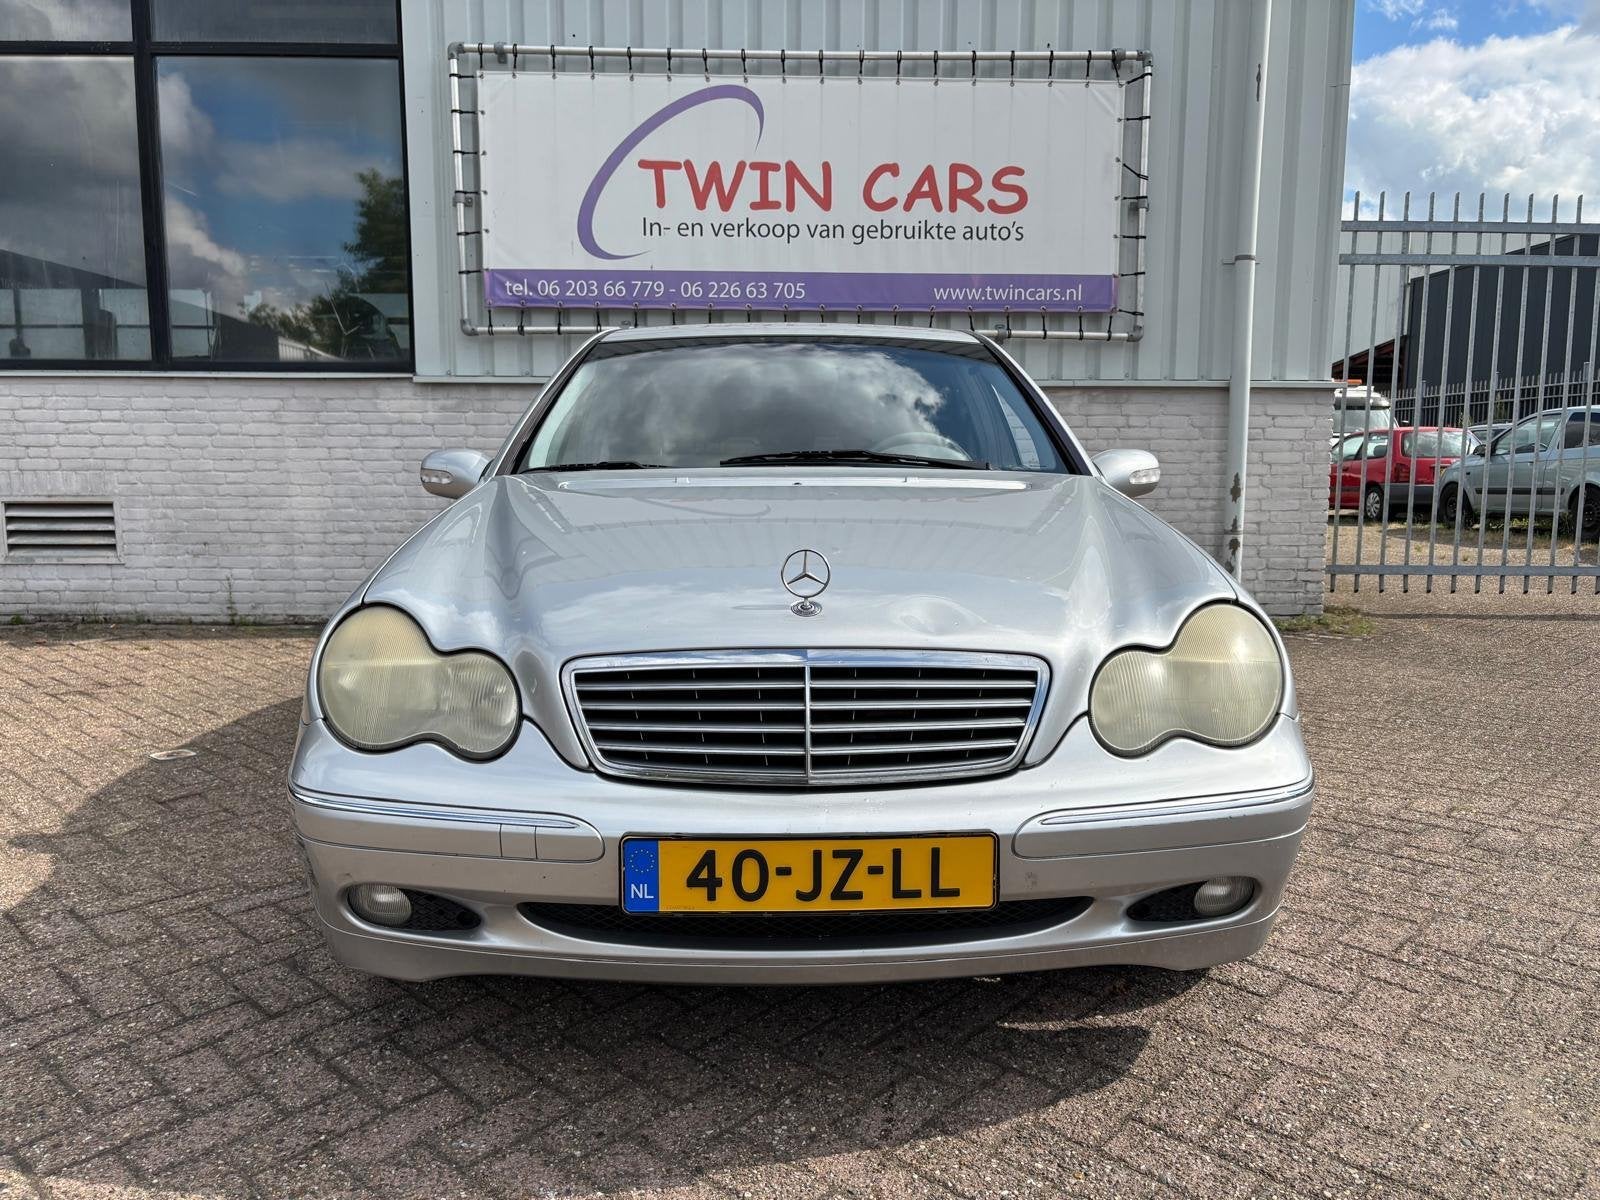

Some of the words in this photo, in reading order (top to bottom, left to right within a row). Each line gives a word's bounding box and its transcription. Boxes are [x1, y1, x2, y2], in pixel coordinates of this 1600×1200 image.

[637, 159, 833, 212] TWIN
[863, 163, 1029, 216] CARS
[642, 217, 671, 237] In-
[677, 222, 704, 237] en
[710, 217, 800, 244] verkoop
[806, 224, 845, 239] van
[851, 218, 957, 246] gebruikte
[962, 220, 1025, 241] auto's
[504, 279, 533, 297] tel.
[537, 279, 561, 297] 06
[565, 279, 598, 297] 203
[603, 280, 626, 297] 66
[631, 281, 665, 298] 779
[680, 281, 703, 298] 06
[708, 281, 741, 298] 226
[745, 282, 768, 299] 63
[773, 282, 806, 299] 705
[933, 283, 1082, 301] www.twincars.nl
[686, 846, 961, 903] 40-JZ-LL
[630, 883, 654, 899] NL
